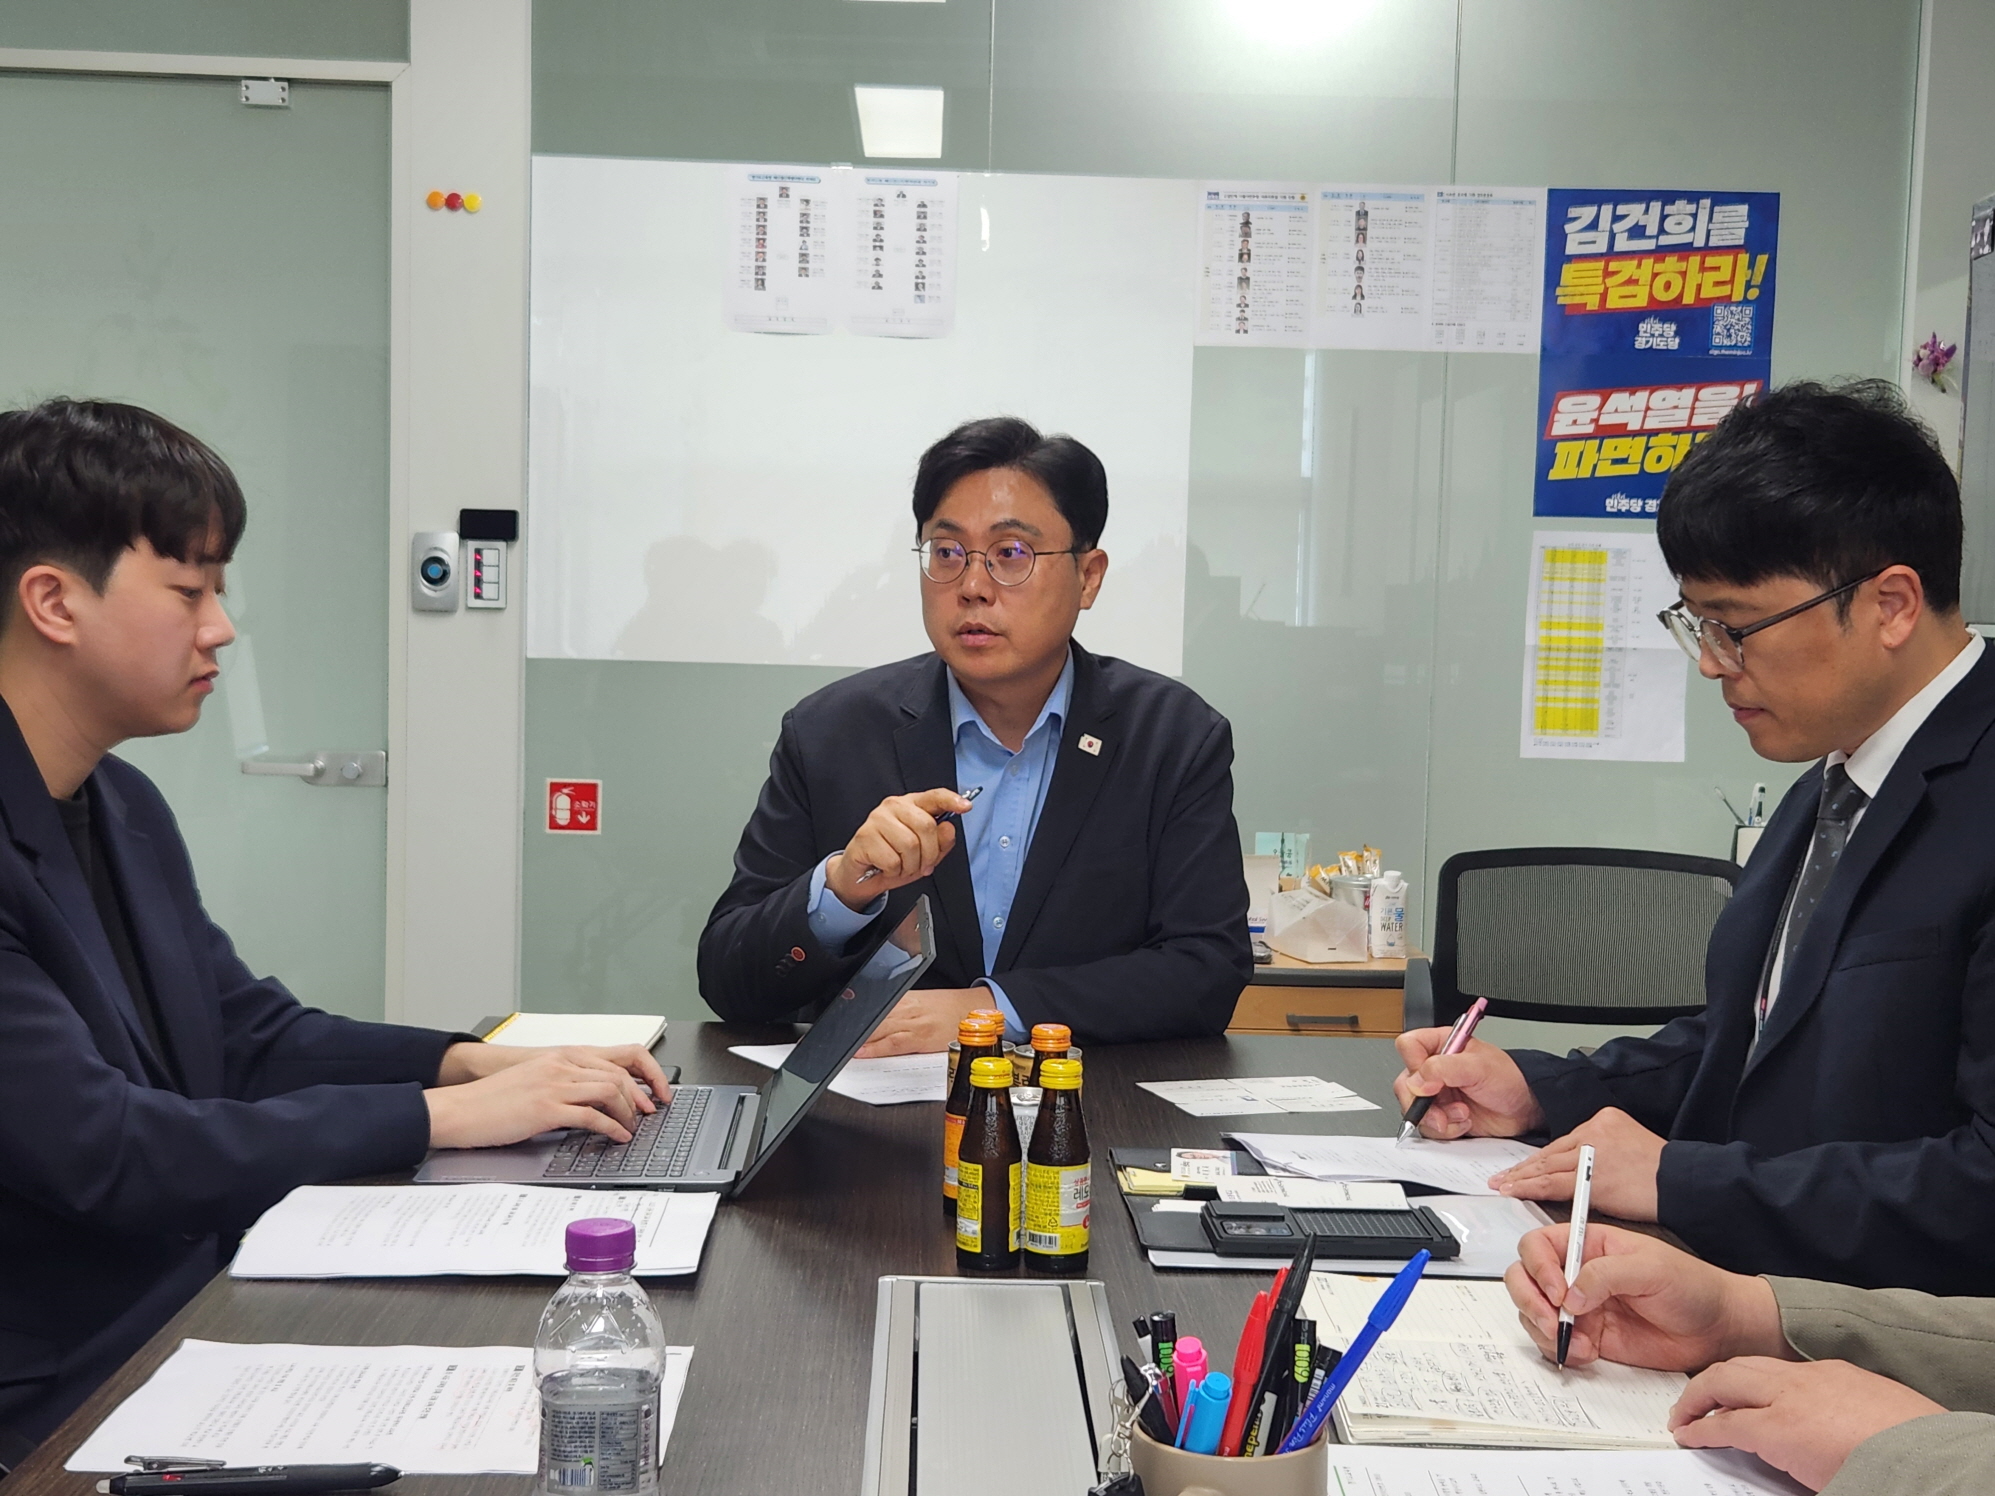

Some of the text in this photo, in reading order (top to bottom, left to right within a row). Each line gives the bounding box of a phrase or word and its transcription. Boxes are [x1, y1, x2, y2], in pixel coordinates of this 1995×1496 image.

[1564, 198, 1749, 255] 김건희를
[1555, 253, 1768, 311] 특검하라!
[1638, 321, 1677, 337] 민주당
[1634, 336, 1680, 350] 경기도당
[1548, 432, 1712, 481] 파면하
[1605, 497, 1660, 512] 민주당 경
[1380, 922, 1404, 932] WATER
[1294, 1346, 1311, 1381] 600
